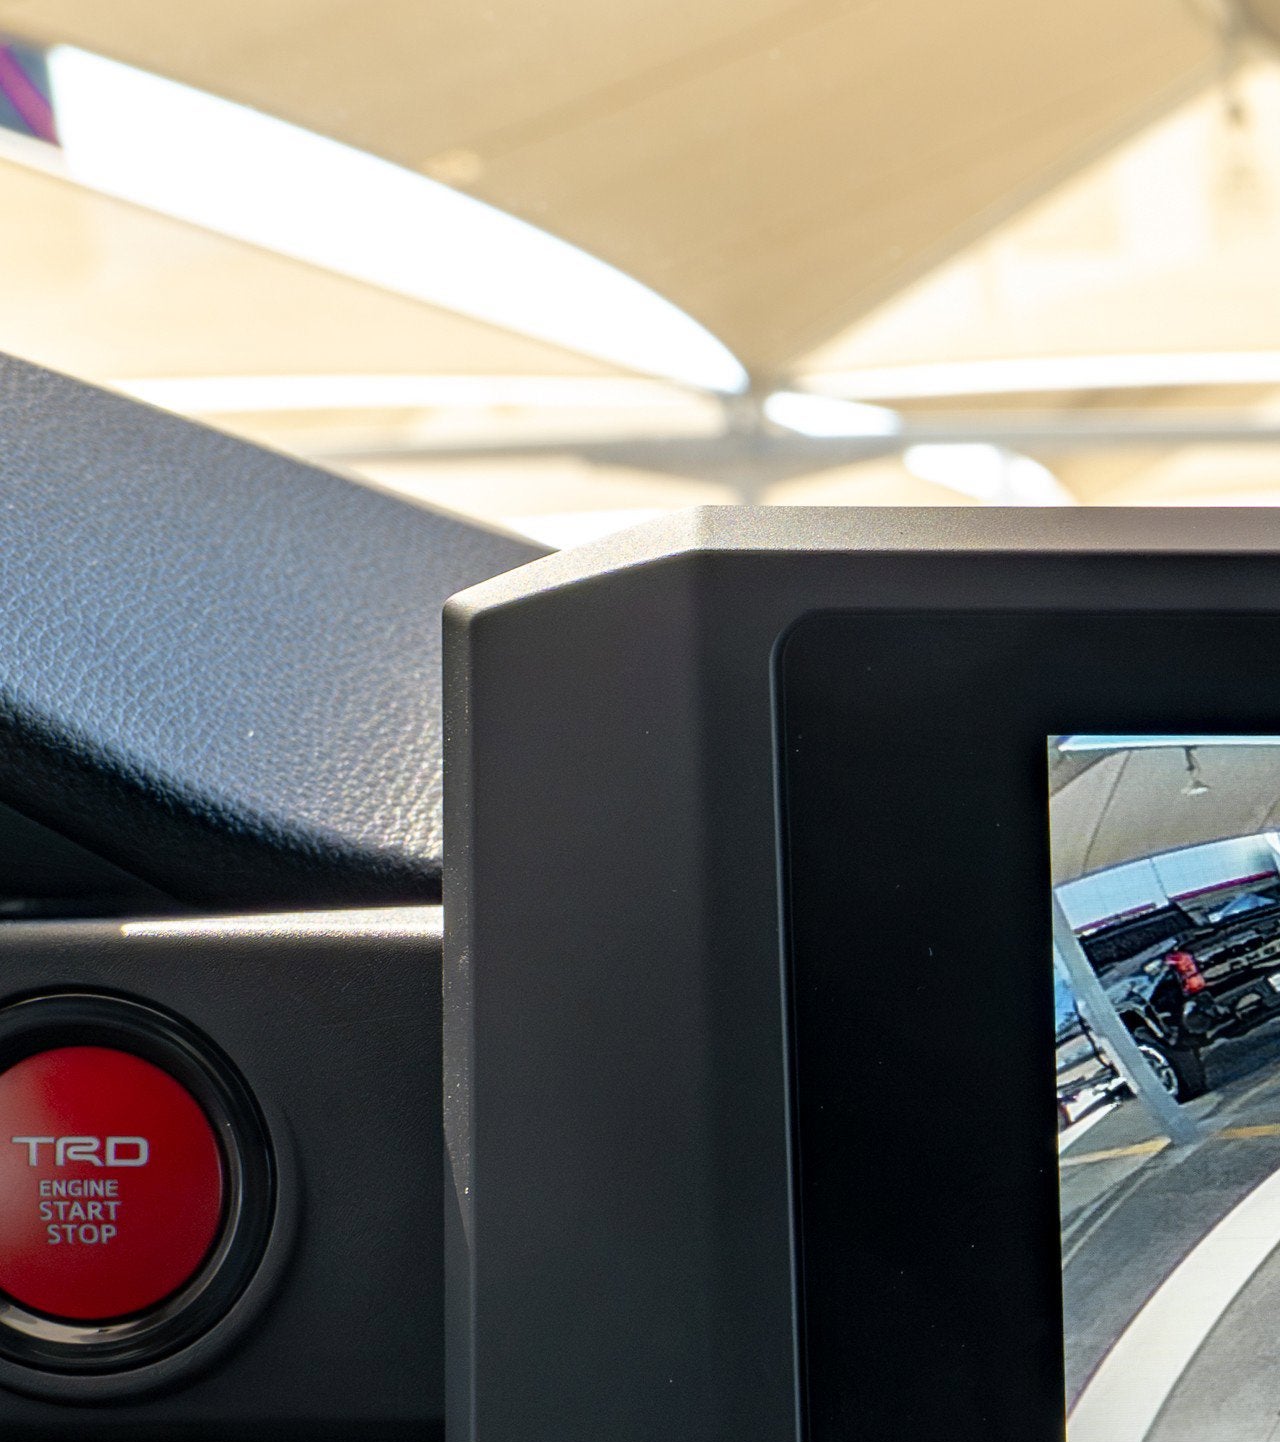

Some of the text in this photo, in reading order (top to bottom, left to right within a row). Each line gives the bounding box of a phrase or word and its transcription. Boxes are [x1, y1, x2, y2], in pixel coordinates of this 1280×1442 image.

[11, 1136, 150, 1168] TRD
[39, 1179, 119, 1198] ENGINE
[39, 1201, 121, 1221] START
[46, 1224, 118, 1244] STOP
